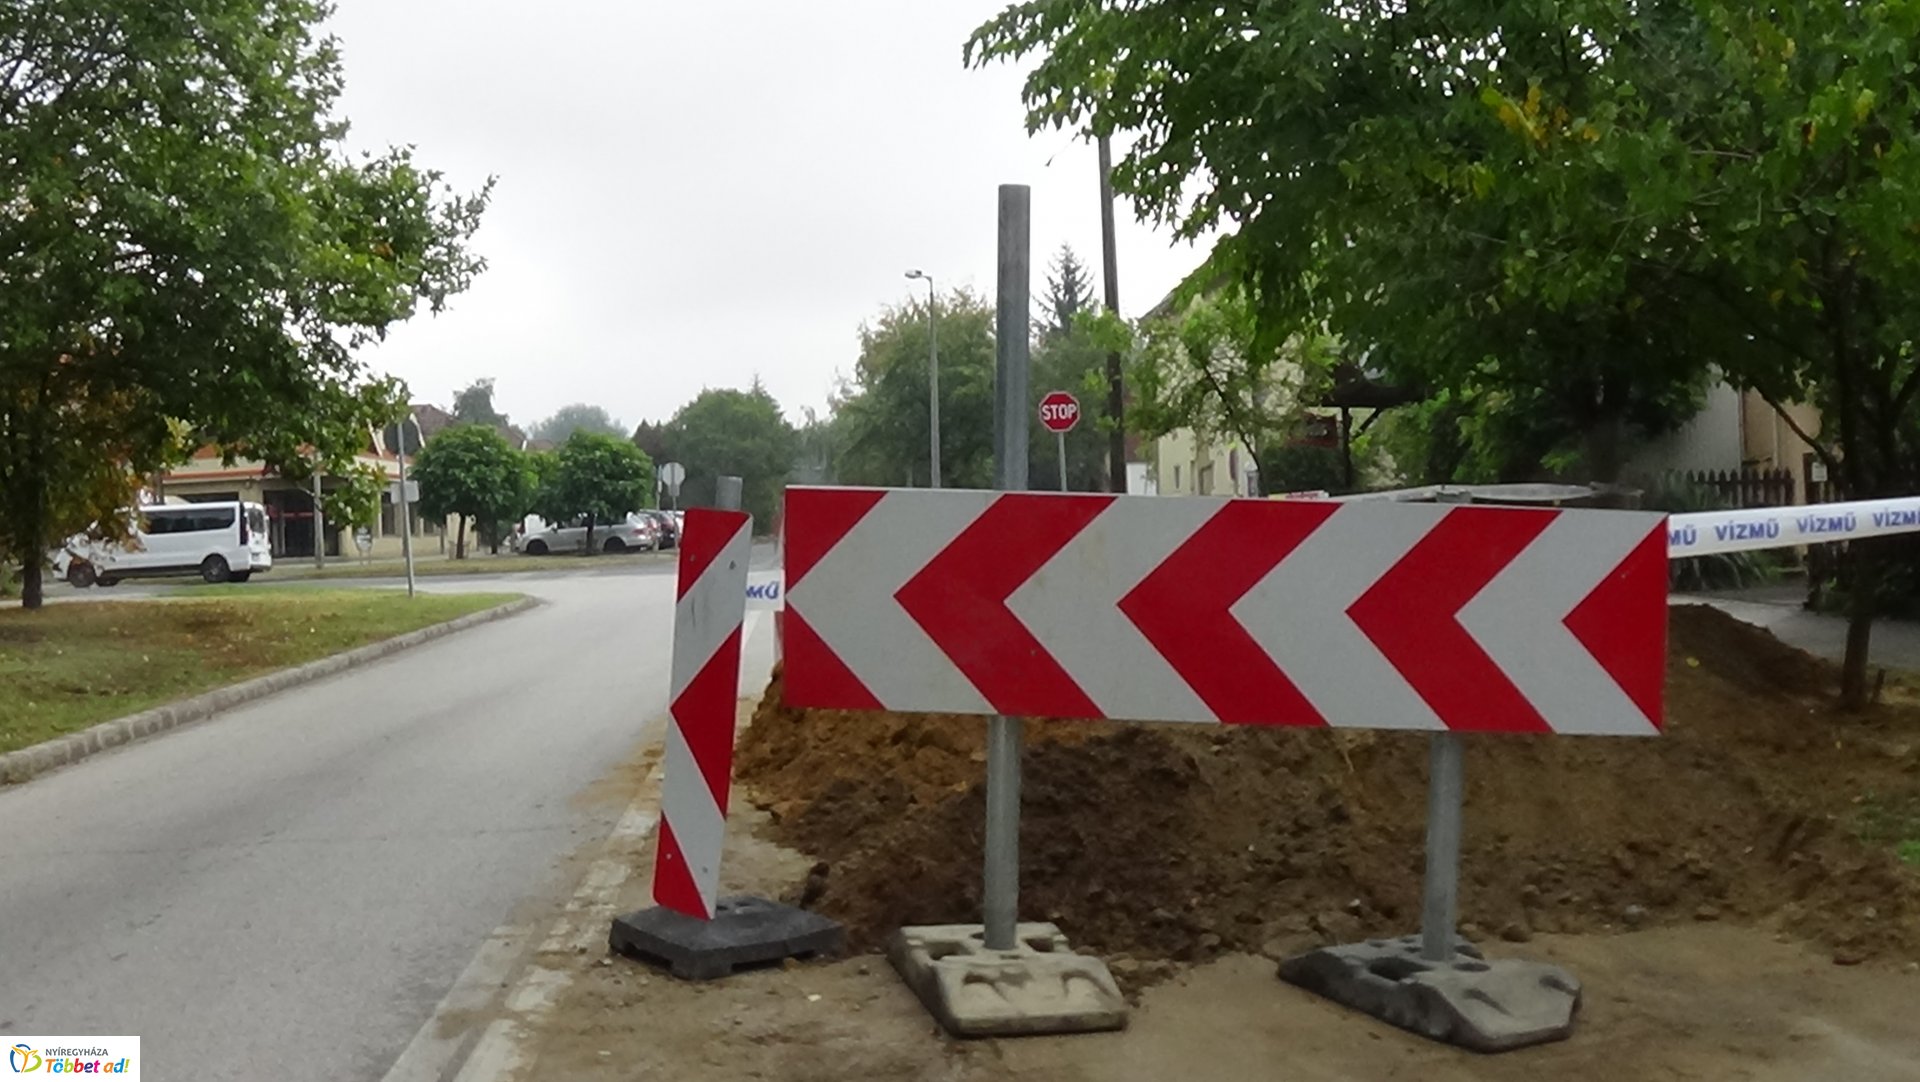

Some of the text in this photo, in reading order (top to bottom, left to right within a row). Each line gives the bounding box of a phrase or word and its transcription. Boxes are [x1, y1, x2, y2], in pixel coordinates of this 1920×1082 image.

[1042, 403, 1077, 421] STOP
[1715, 517, 1780, 542] VÍZMŰ
[1795, 511, 1857, 534] VÍZMŰ
[1872, 506, 1920, 528] VÍZM
